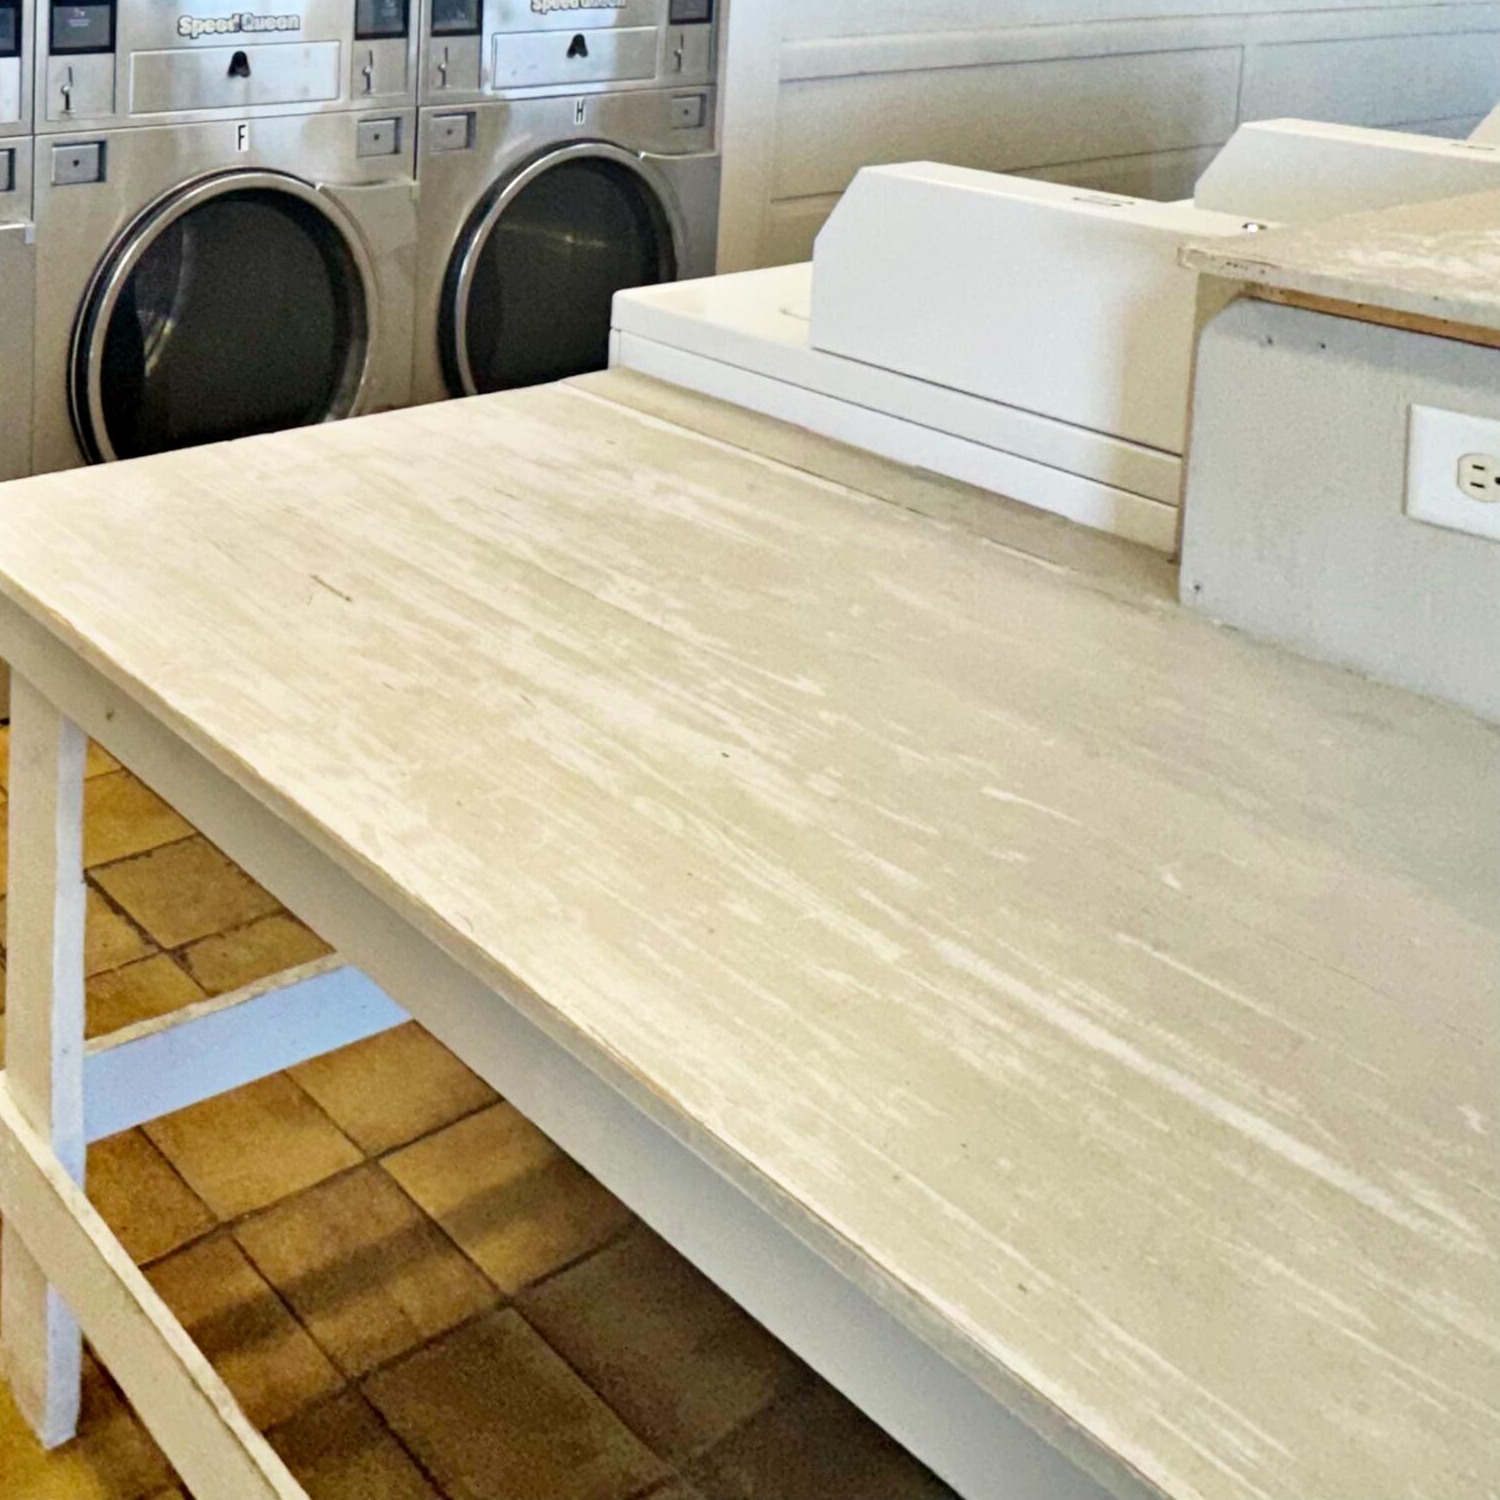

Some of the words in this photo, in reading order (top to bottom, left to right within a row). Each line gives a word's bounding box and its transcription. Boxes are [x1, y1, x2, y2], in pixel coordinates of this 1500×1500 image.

[178, 13, 240, 39] Speed
[240, 12, 300, 32] Queen
[576, 99, 586, 123] H
[237, 124, 247, 151] F
